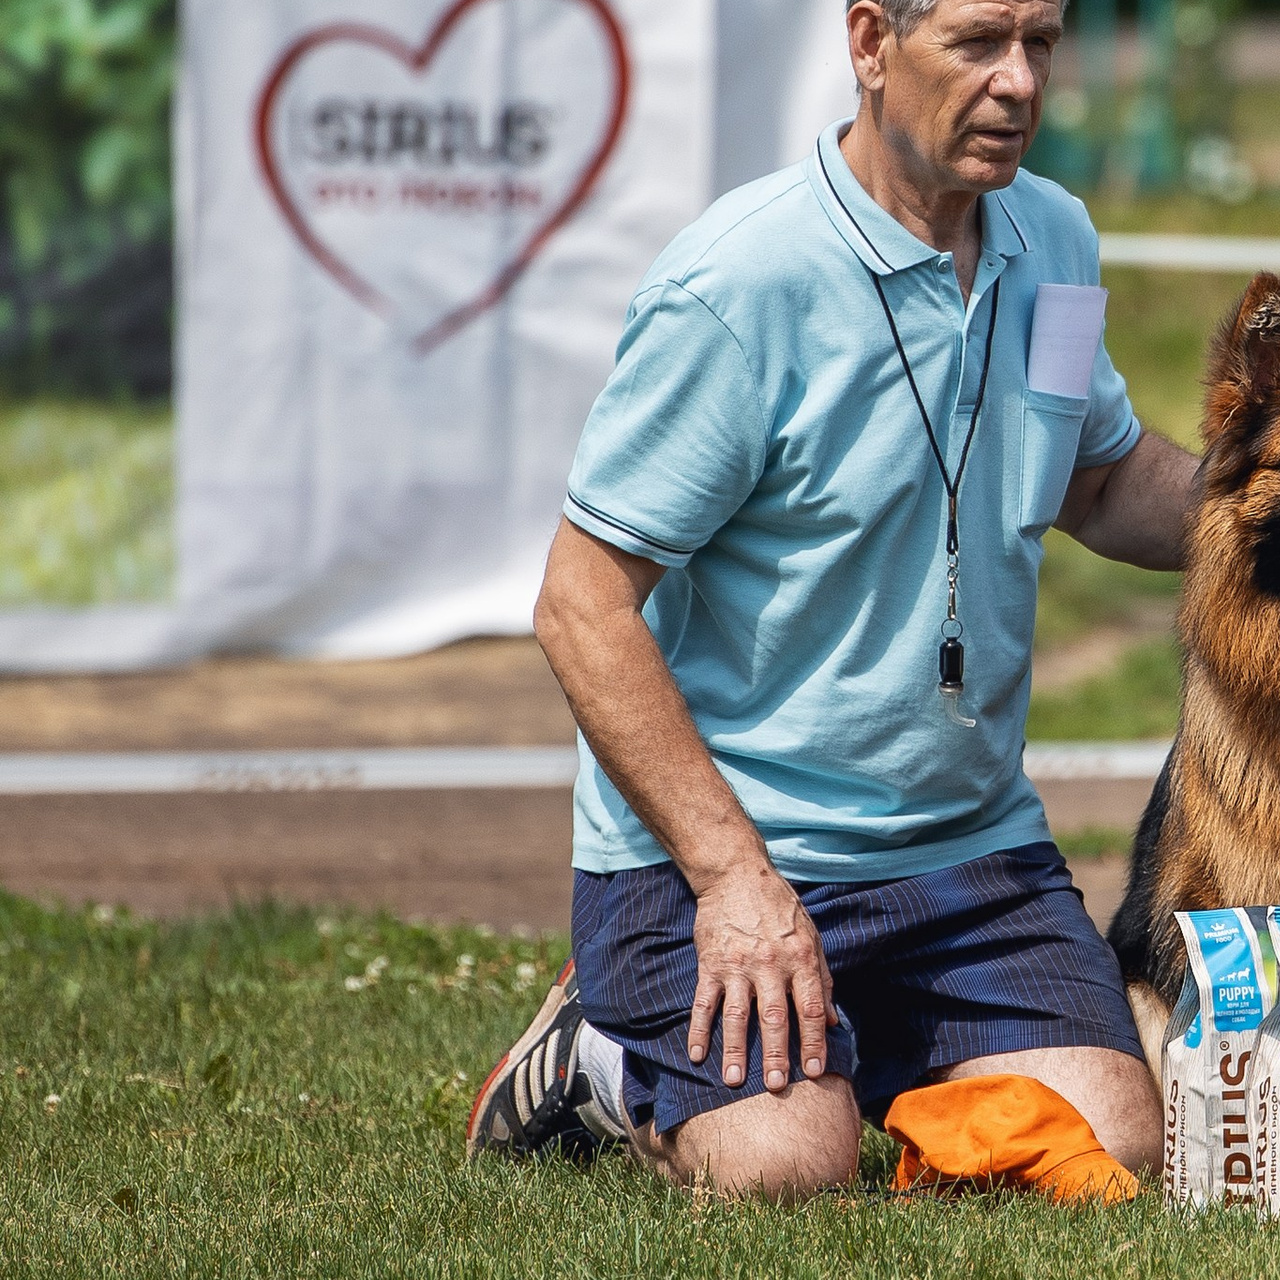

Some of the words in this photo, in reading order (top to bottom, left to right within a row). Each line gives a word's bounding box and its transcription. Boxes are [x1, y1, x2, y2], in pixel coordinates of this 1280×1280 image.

[311, 96, 552, 167] SIRIUS
[1219, 986, 1255, 1003] PUPPY
[1179, 1095, 1187, 1137] РИСОМ
[1179, 1151, 1187, 1203] ЯГНЕНОК
[1270, 1142, 1278, 1196] ЯГНЕНОК
